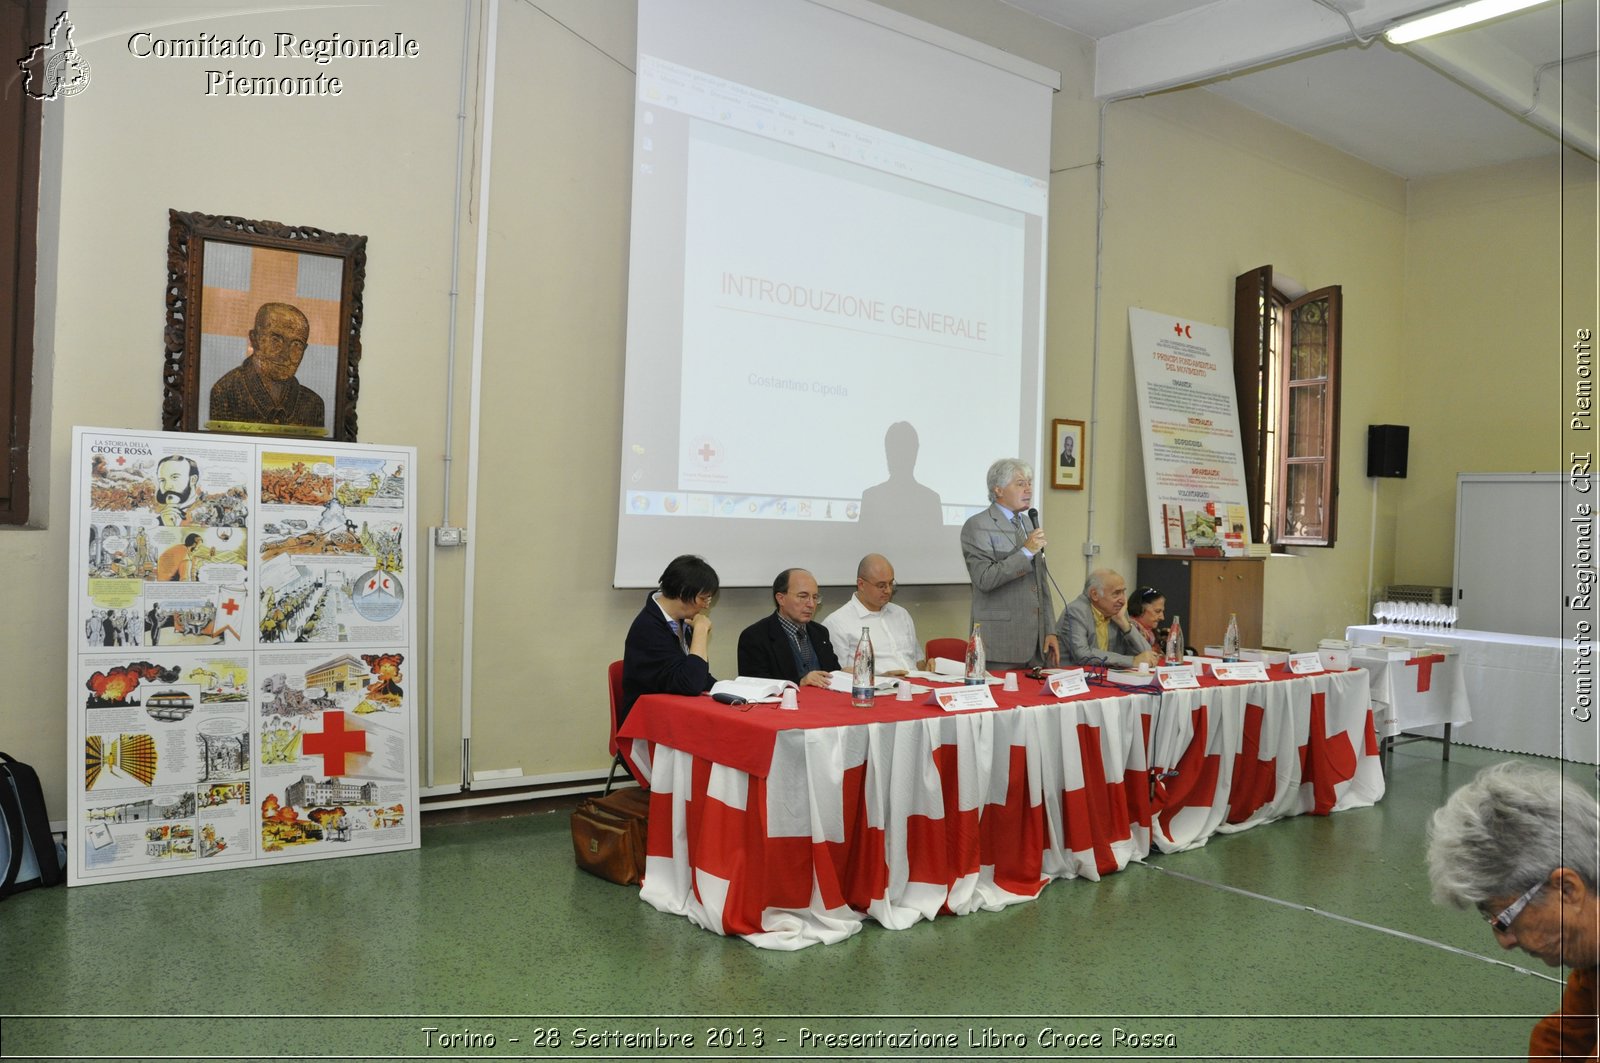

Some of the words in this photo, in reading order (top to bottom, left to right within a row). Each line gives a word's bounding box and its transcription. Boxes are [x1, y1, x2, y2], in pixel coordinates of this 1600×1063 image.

[720, 271, 885, 323] INTRODUZIONE
[890, 305, 988, 342] GENERALE
[748, 372, 809, 393] Costantino
[812, 380, 849, 399] Cipolla
[91, 445, 123, 455] CROCE
[124, 447, 153, 456] ROSSA
